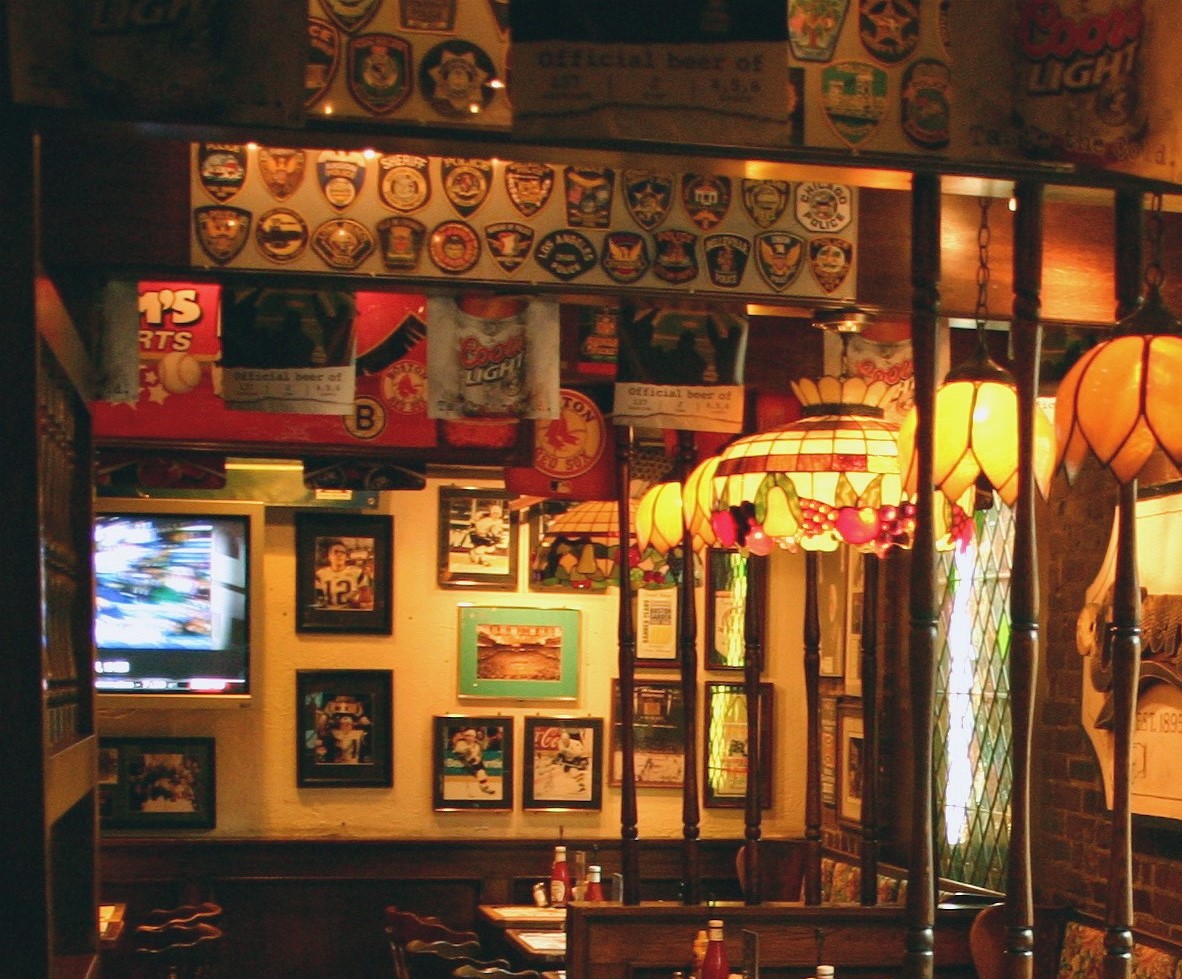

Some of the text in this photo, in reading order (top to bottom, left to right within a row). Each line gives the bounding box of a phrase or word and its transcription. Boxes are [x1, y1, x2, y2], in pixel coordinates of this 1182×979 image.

[802, 212, 845, 229] POLICE
[628, 387, 732, 400] Official beer of
[356, 404, 375, 431] B
